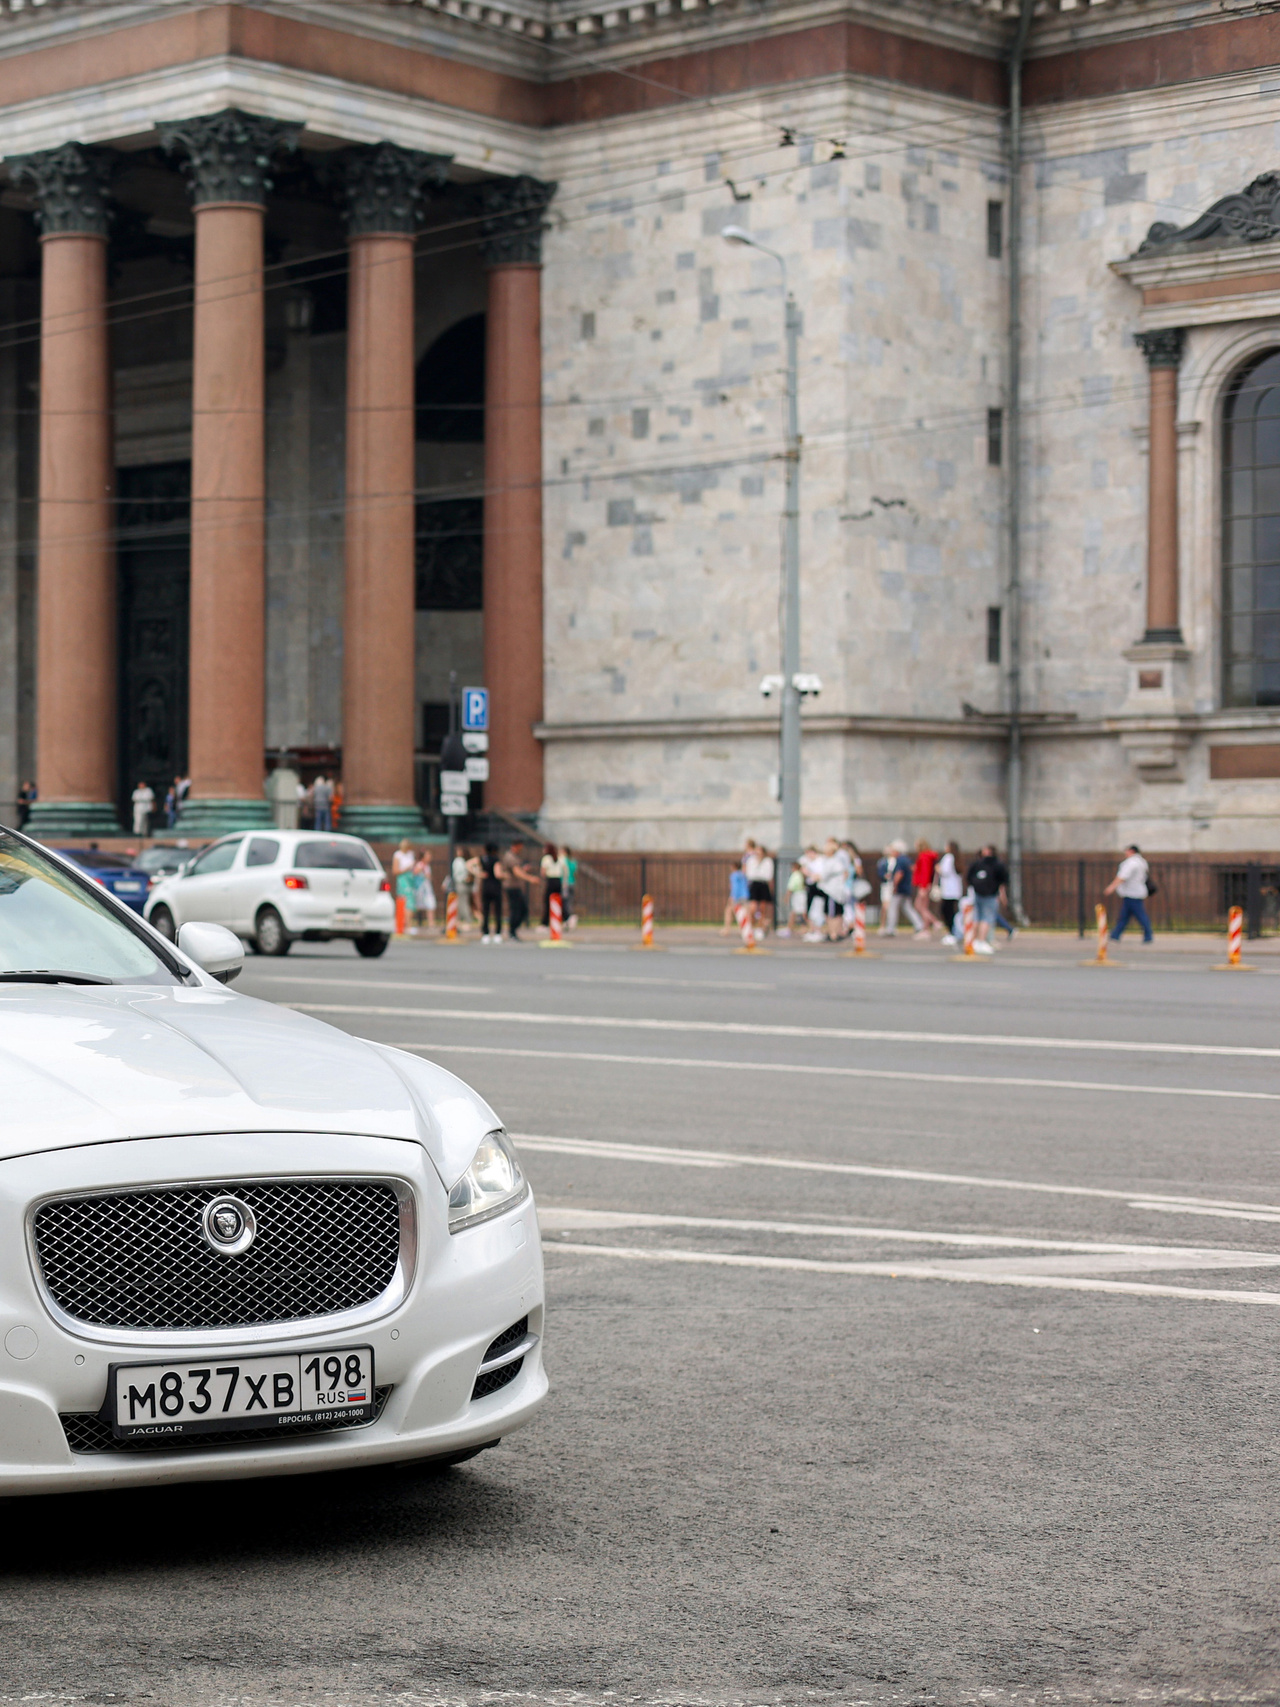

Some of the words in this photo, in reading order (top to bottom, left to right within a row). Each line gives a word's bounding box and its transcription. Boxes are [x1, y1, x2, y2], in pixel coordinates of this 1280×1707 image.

[128, 1366, 294, 1420] М837ХВ
[304, 1354, 363, 1392] 198
[317, 1390, 346, 1405] RUS
[278, 1414, 313, 1424] ЕВРОСИБ,
[314, 1411, 333, 1422] (812)
[333, 1408, 364, 1419] 240-1000
[127, 1424, 183, 1436] JAGUAR
